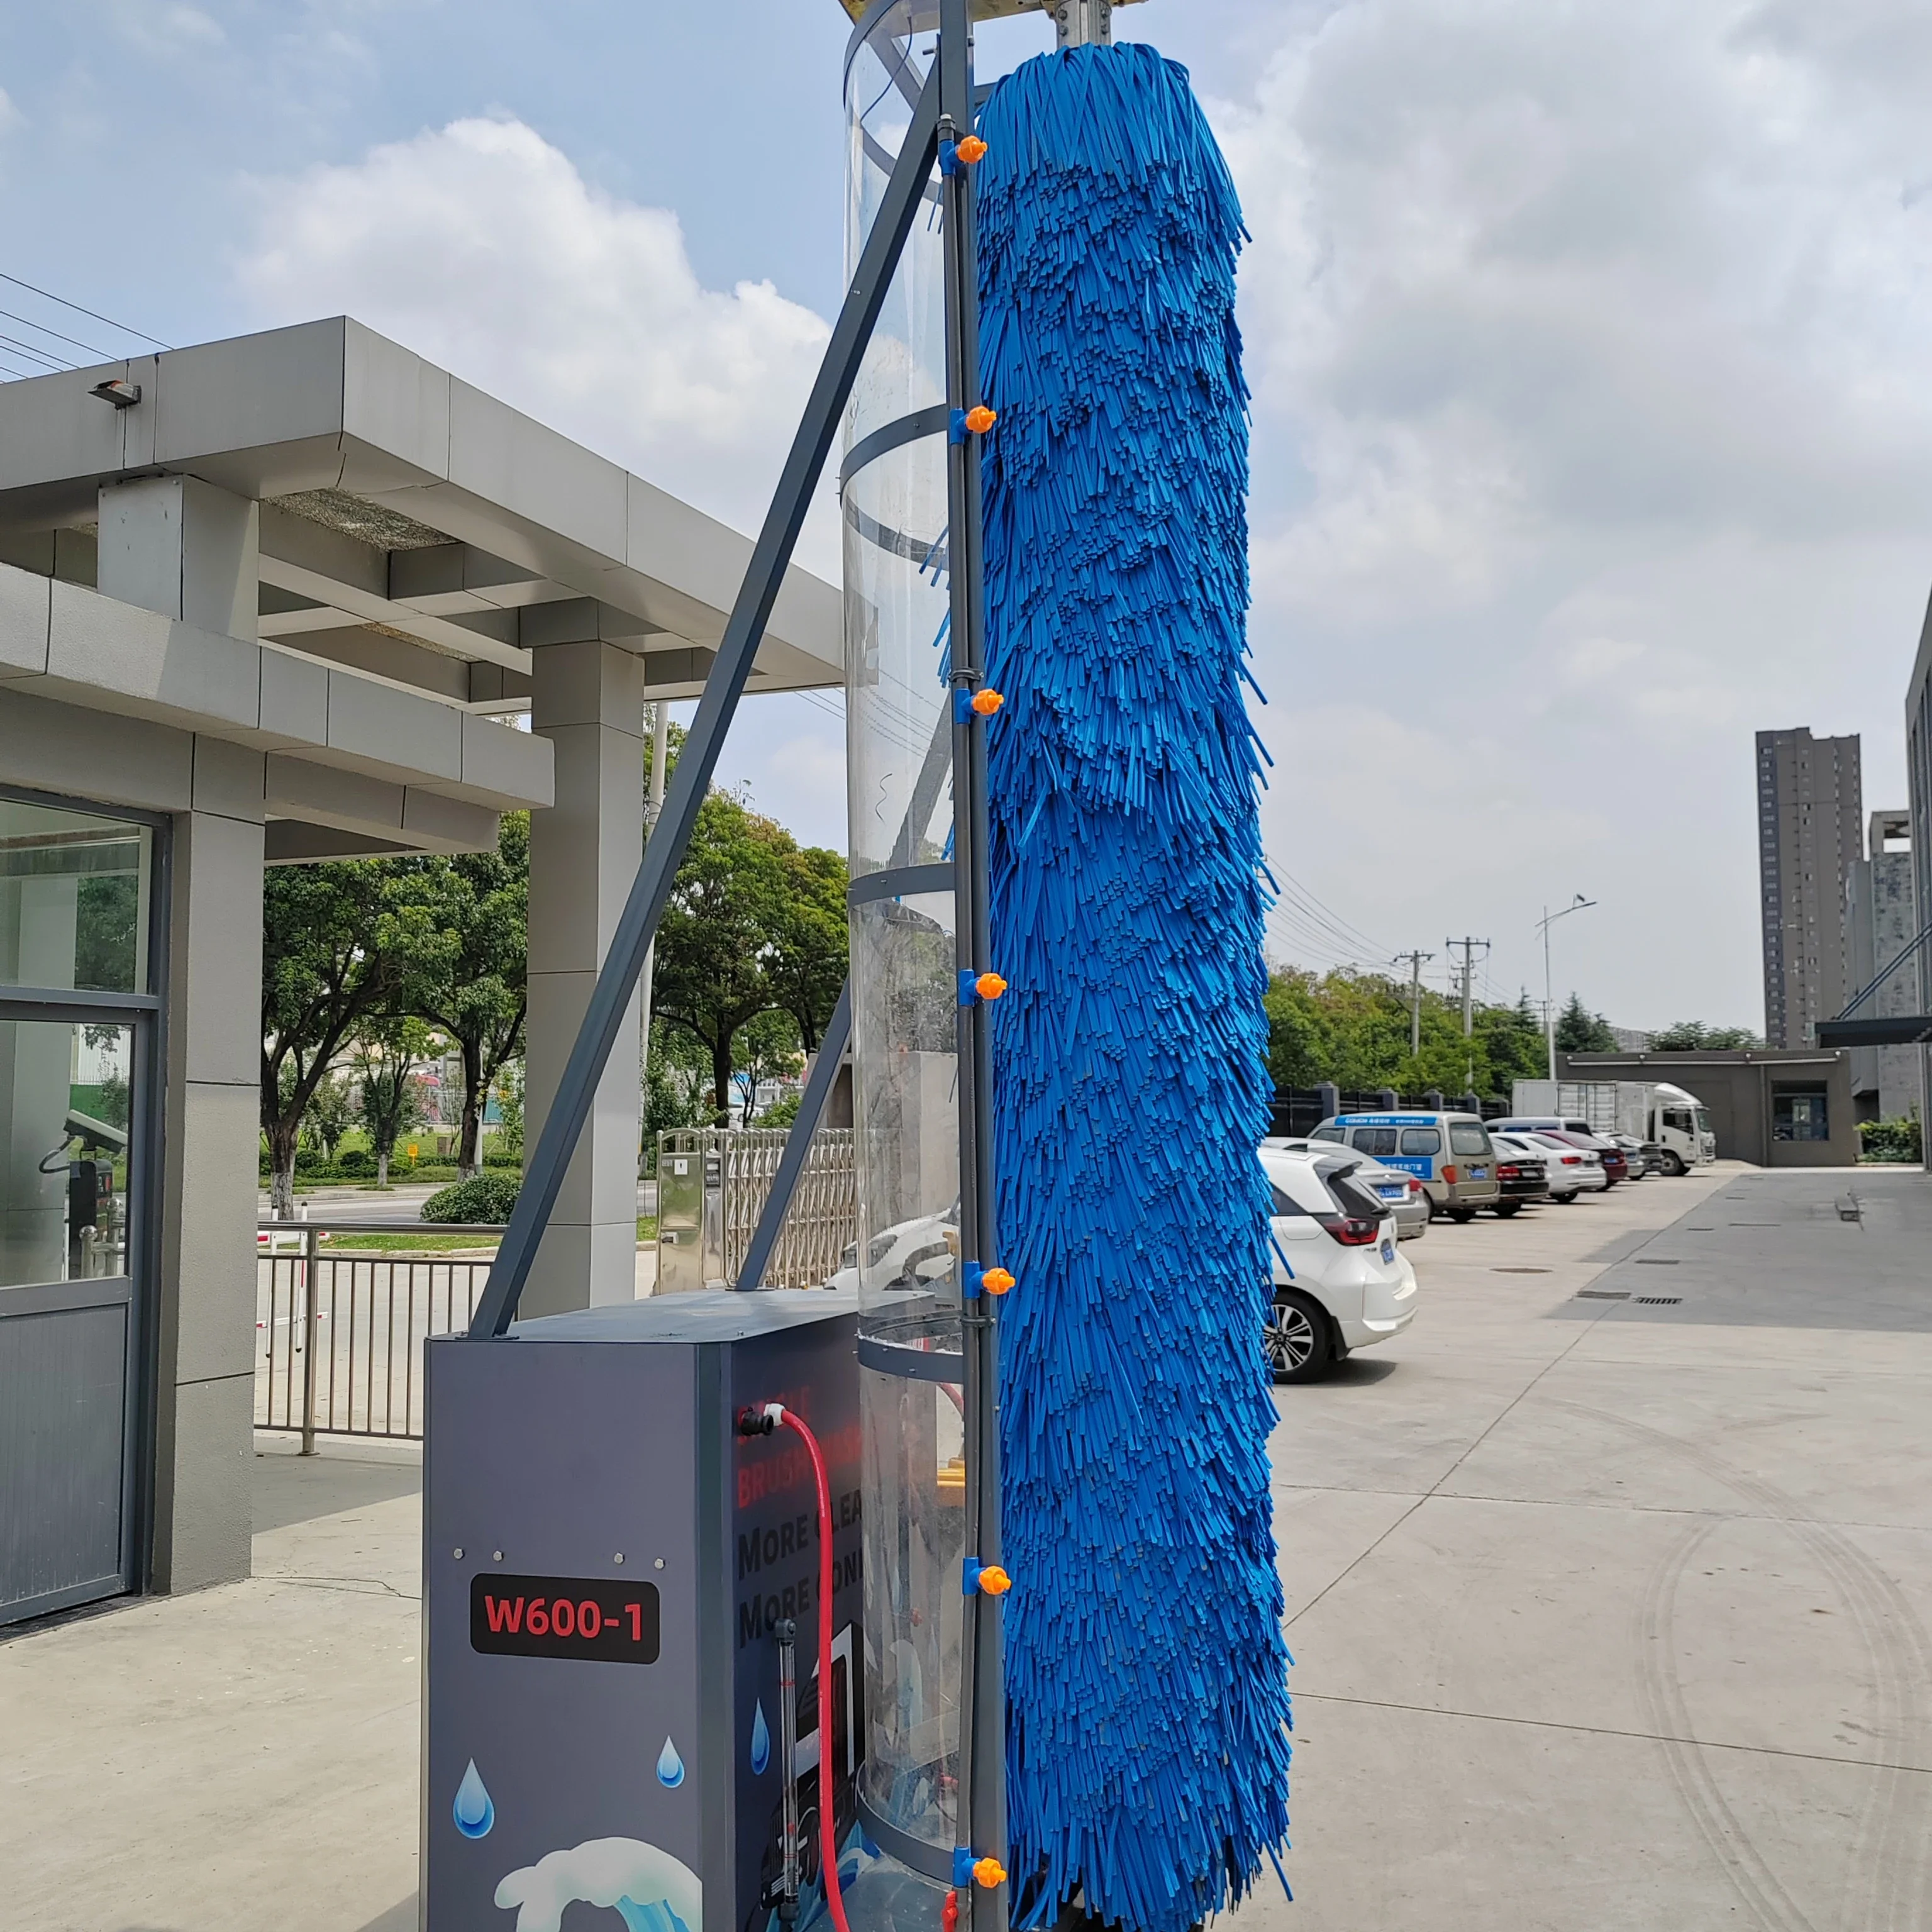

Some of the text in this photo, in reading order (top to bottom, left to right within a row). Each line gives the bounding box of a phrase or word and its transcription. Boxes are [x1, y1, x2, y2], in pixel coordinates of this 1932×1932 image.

[738, 1514, 809, 1581] MORE
[484, 1596, 641, 1641] W600-1
[740, 1577, 811, 1649] MORE
